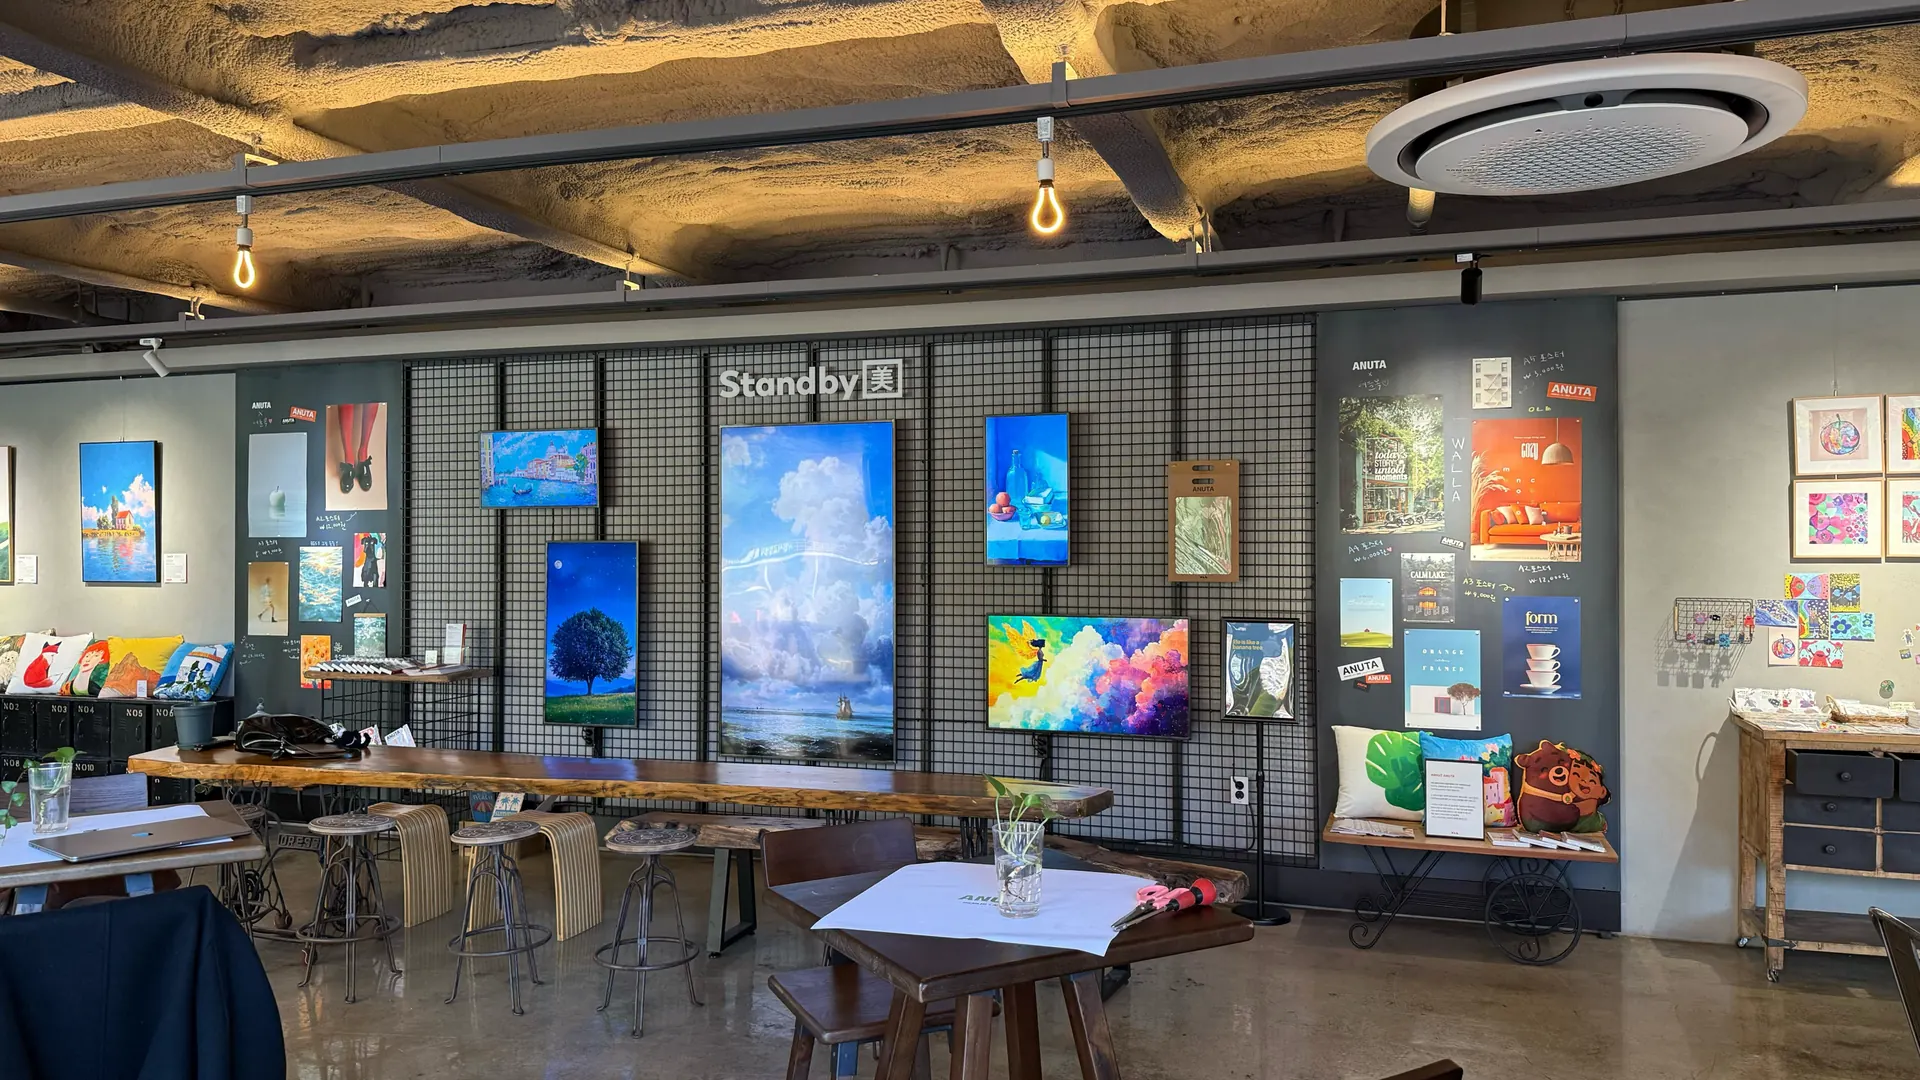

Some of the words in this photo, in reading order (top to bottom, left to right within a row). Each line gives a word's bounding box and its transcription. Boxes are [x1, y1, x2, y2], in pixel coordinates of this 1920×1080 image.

[1352, 360, 1387, 370] ANUTA
[719, 366, 859, 400] Standby
[871, 365, 894, 392] 美
[1551, 384, 1592, 397] ANUTA
[251, 401, 272, 410] ANUTA
[292, 408, 314, 418] ANUTA
[1375, 449, 1408, 460] today's
[1375, 464, 1405, 474] untold
[1441, 537, 1464, 548] ANUTA
[1410, 571, 1428, 579] CALM
[1429, 571, 1446, 579] LAKE
[1526, 611, 1557, 625] form
[1343, 660, 1379, 675] ANUTA
[51, 704, 67, 713] NO3
[78, 705, 95, 714] NO4
[126, 709, 143, 718] NO5
[3, 758, 20, 767] NO8
[75, 763, 95, 772] NO10
